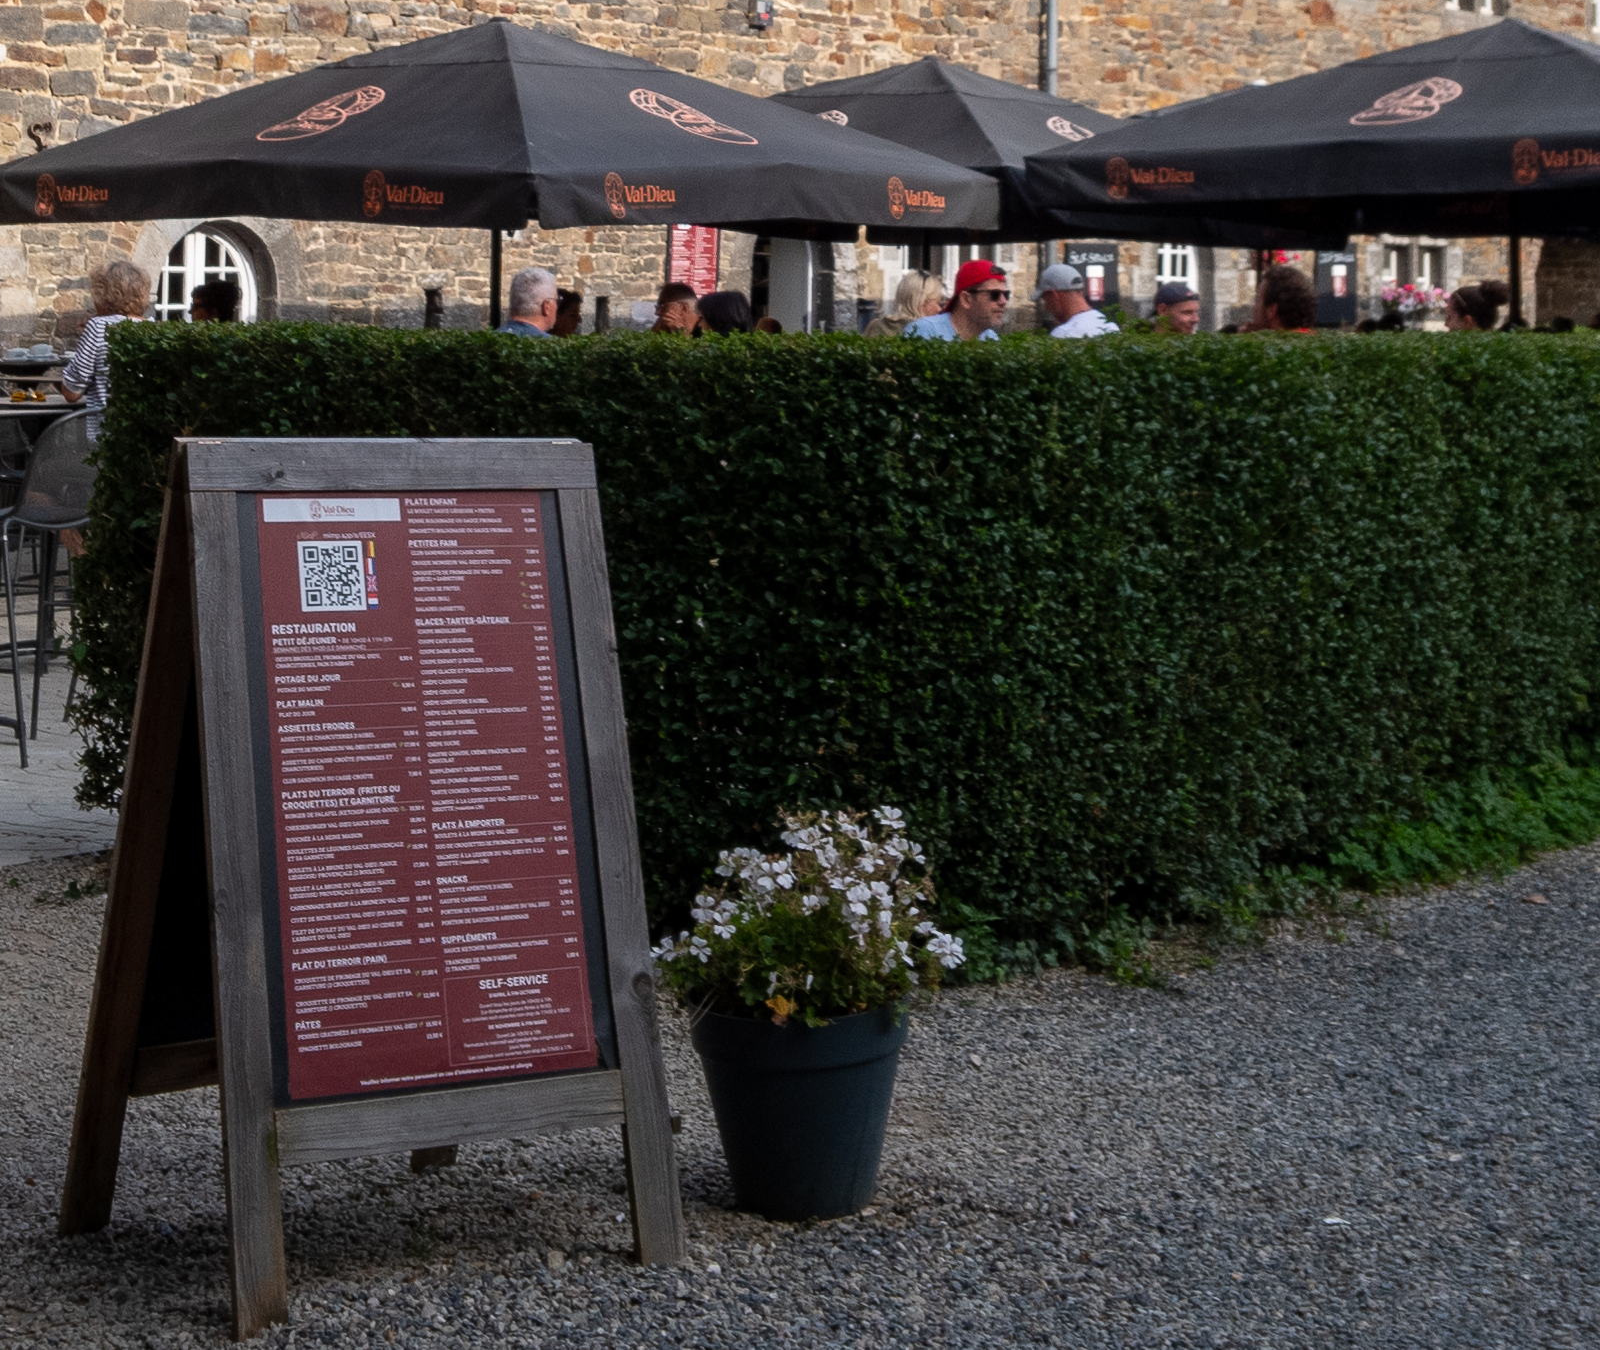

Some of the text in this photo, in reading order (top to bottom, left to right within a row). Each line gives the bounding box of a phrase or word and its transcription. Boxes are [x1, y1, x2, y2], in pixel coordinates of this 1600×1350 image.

[56, 185, 109, 202] Val-Dieu
[385, 183, 444, 204] Val-Dieu
[624, 184, 676, 203] Val-Dieu
[904, 189, 946, 207] Val-Dieu
[271, 622, 356, 634] RESTAURATION
[296, 635, 336, 645] DÉJEUNER
[274, 675, 305, 683] POTAGE
[307, 674, 318, 682] DU
[276, 699, 323, 708] PLAT MALIN
[277, 722, 355, 732] ASSIETTES FROIDES
[281, 785, 400, 799] PLATS DU TERROIR (FRITES OU
[282, 795, 394, 810] CROQUETTES) ET GARNITURE
[431, 816, 505, 830] PLATS À EMPORTER
[436, 875, 468, 884] SNACKS
[441, 931, 497, 944] SUPPLÉMENTS
[291, 954, 387, 970] PLAT DU TERROIR (PAIN)
[478, 974, 548, 990] SELF-SERVICE
[294, 1019, 321, 1030] PÂTES
